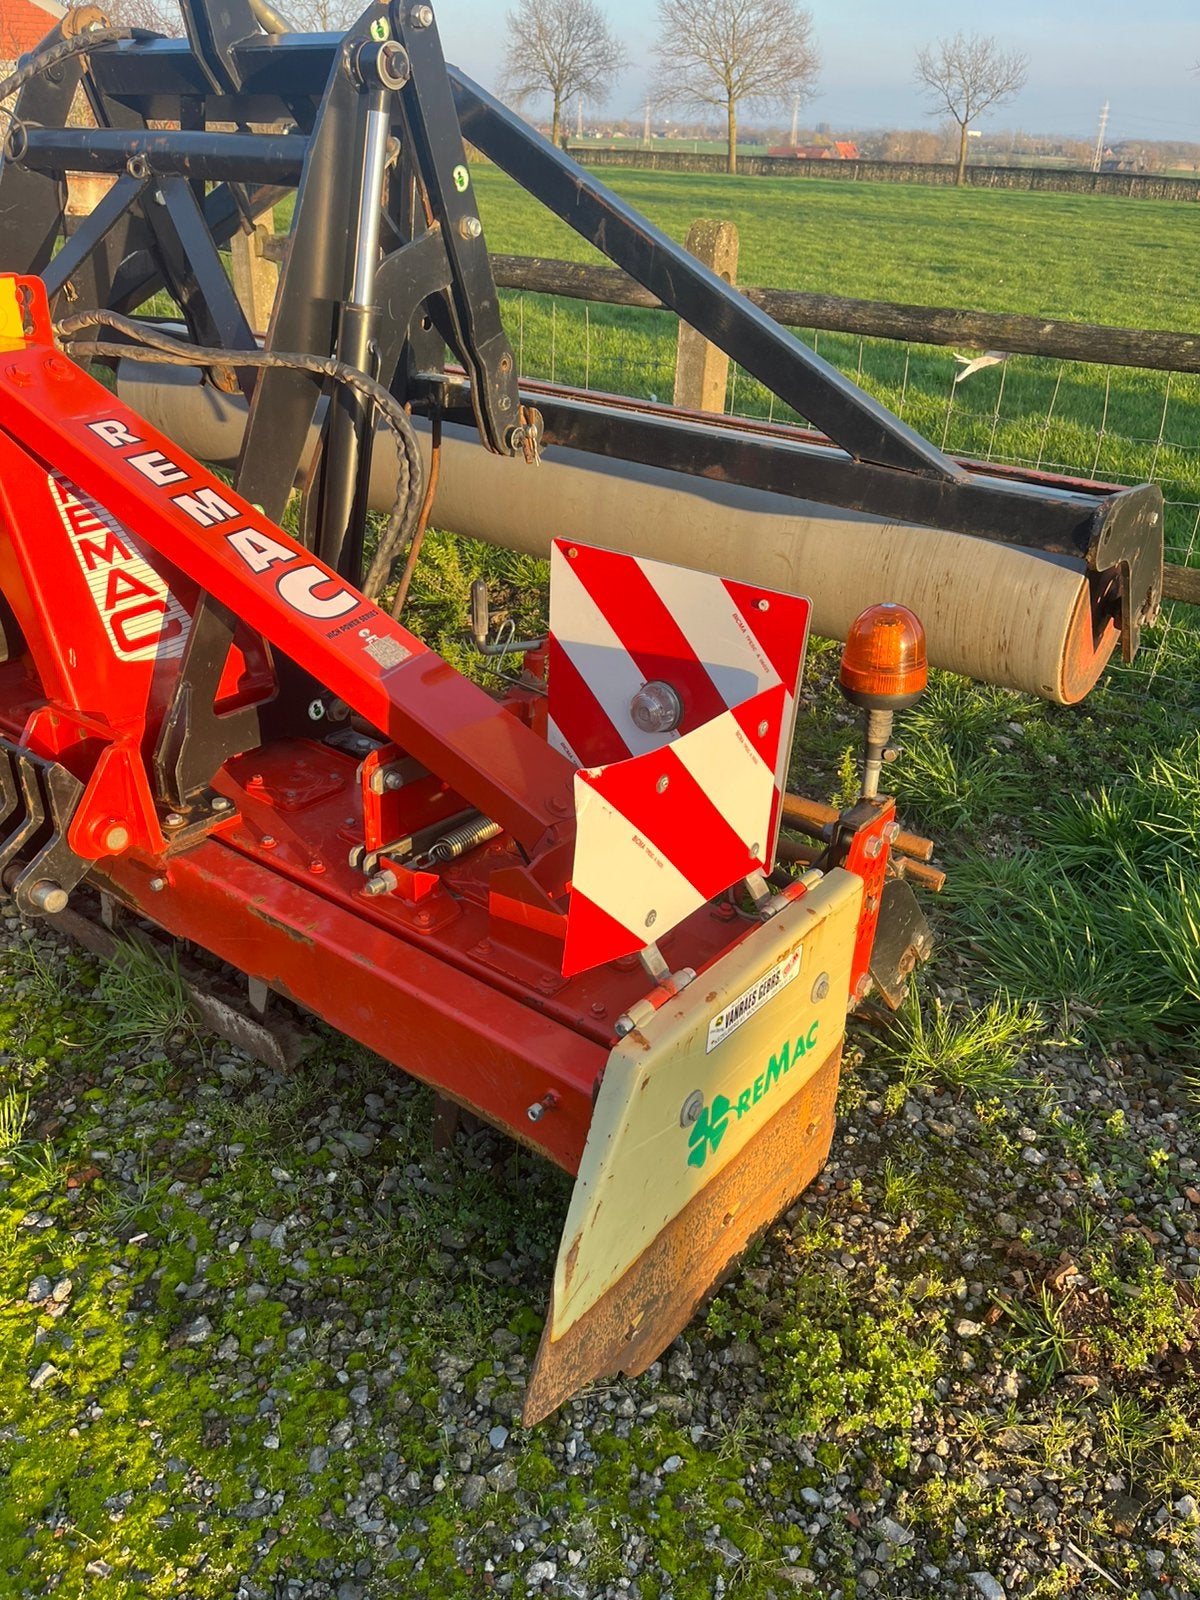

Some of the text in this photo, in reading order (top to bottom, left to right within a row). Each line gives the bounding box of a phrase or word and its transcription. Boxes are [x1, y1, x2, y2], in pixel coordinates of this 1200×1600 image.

[85, 418, 361, 620] REMAC
[325, 609, 379, 639] HIGH POWER SERIES
[732, 613, 746, 633] BICMA
